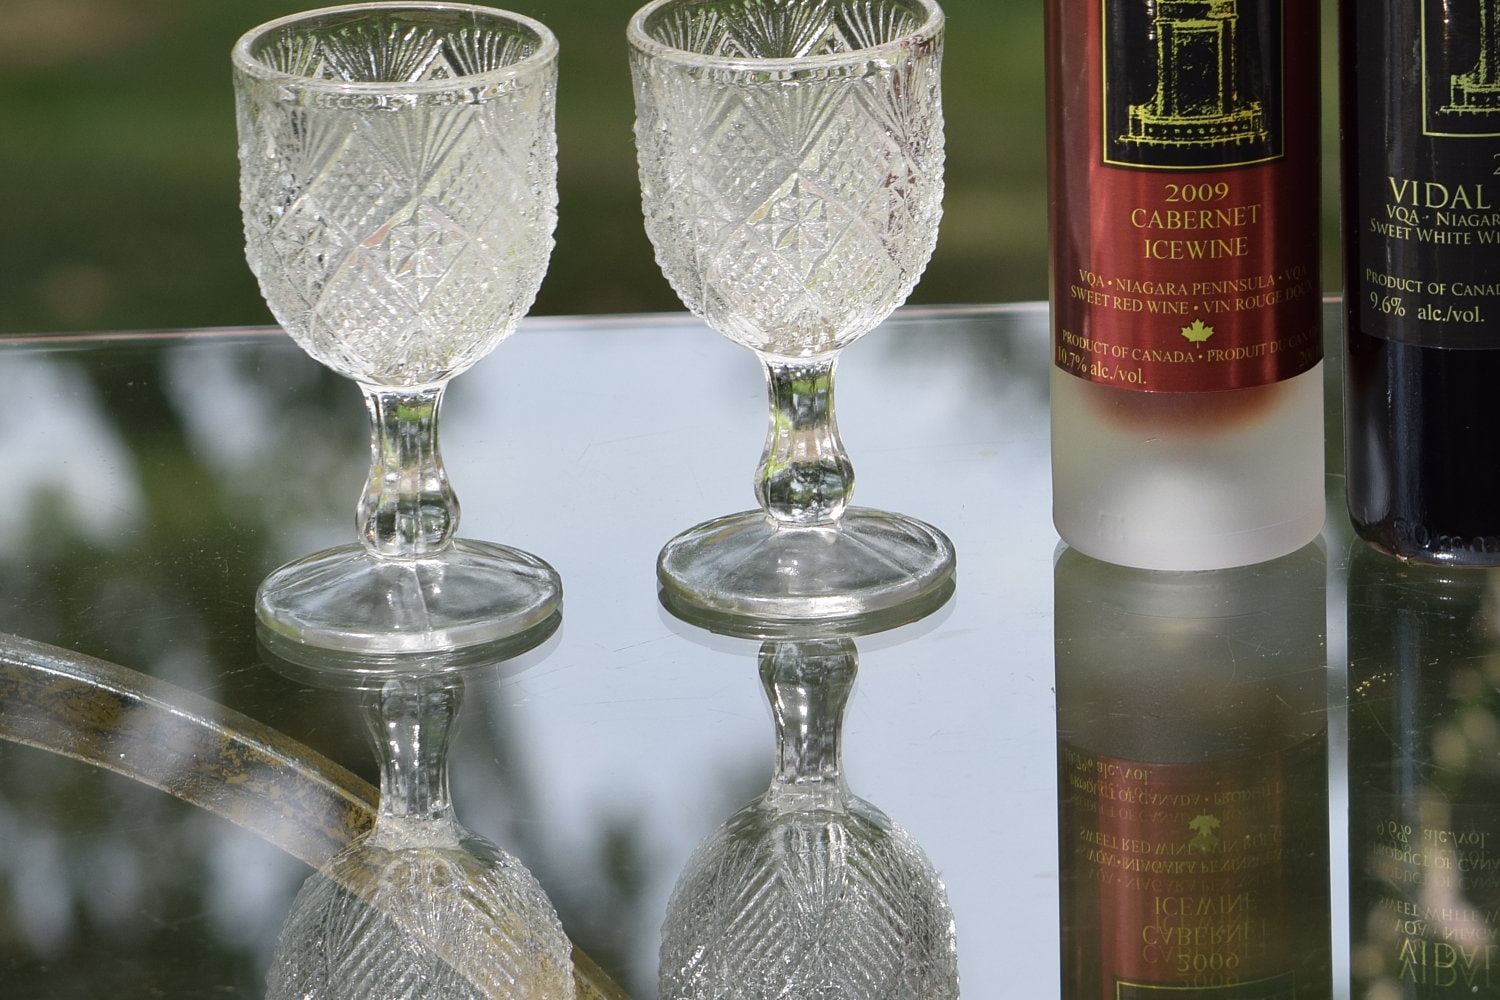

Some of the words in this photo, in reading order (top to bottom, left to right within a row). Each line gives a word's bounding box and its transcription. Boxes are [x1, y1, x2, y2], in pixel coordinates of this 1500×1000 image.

[1164, 181, 1230, 203] 2009
[1387, 176, 1491, 210] VIDAL
[1130, 203, 1262, 230] CABERNET
[1385, 203, 1419, 228] VQA
[1369, 216, 1412, 241] SWEET
[1416, 227, 1472, 246] WHITE
[1143, 236, 1250, 260] ICEWINE
[1078, 268, 1105, 289] VQA
[1115, 278, 1189, 296] NIAGARA
[1192, 274, 1277, 296] PENINSULA
[1365, 267, 1422, 294] PRODUCT
[1427, 281, 1447, 296] OF
[1070, 284, 1110, 308] SWEET
[1112, 297, 1143, 312] RED
[1147, 299, 1190, 315] WINE
[1203, 300, 1232, 314] VIN
[1235, 292, 1283, 311] ROUGE
[1369, 290, 1407, 318] 9.6%
[1416, 303, 1486, 323] alc./vol.
[1061, 328, 1110, 356] PRODUCT
[1111, 345, 1129, 361] OF
[1131, 349, 1195, 363] CANADA
[1206, 343, 1268, 363] PRODUIT
[1269, 337, 1287, 354] DU
[1057, 345, 1088, 374] 10.7%
[1089, 361, 1148, 385] alc./vol.
